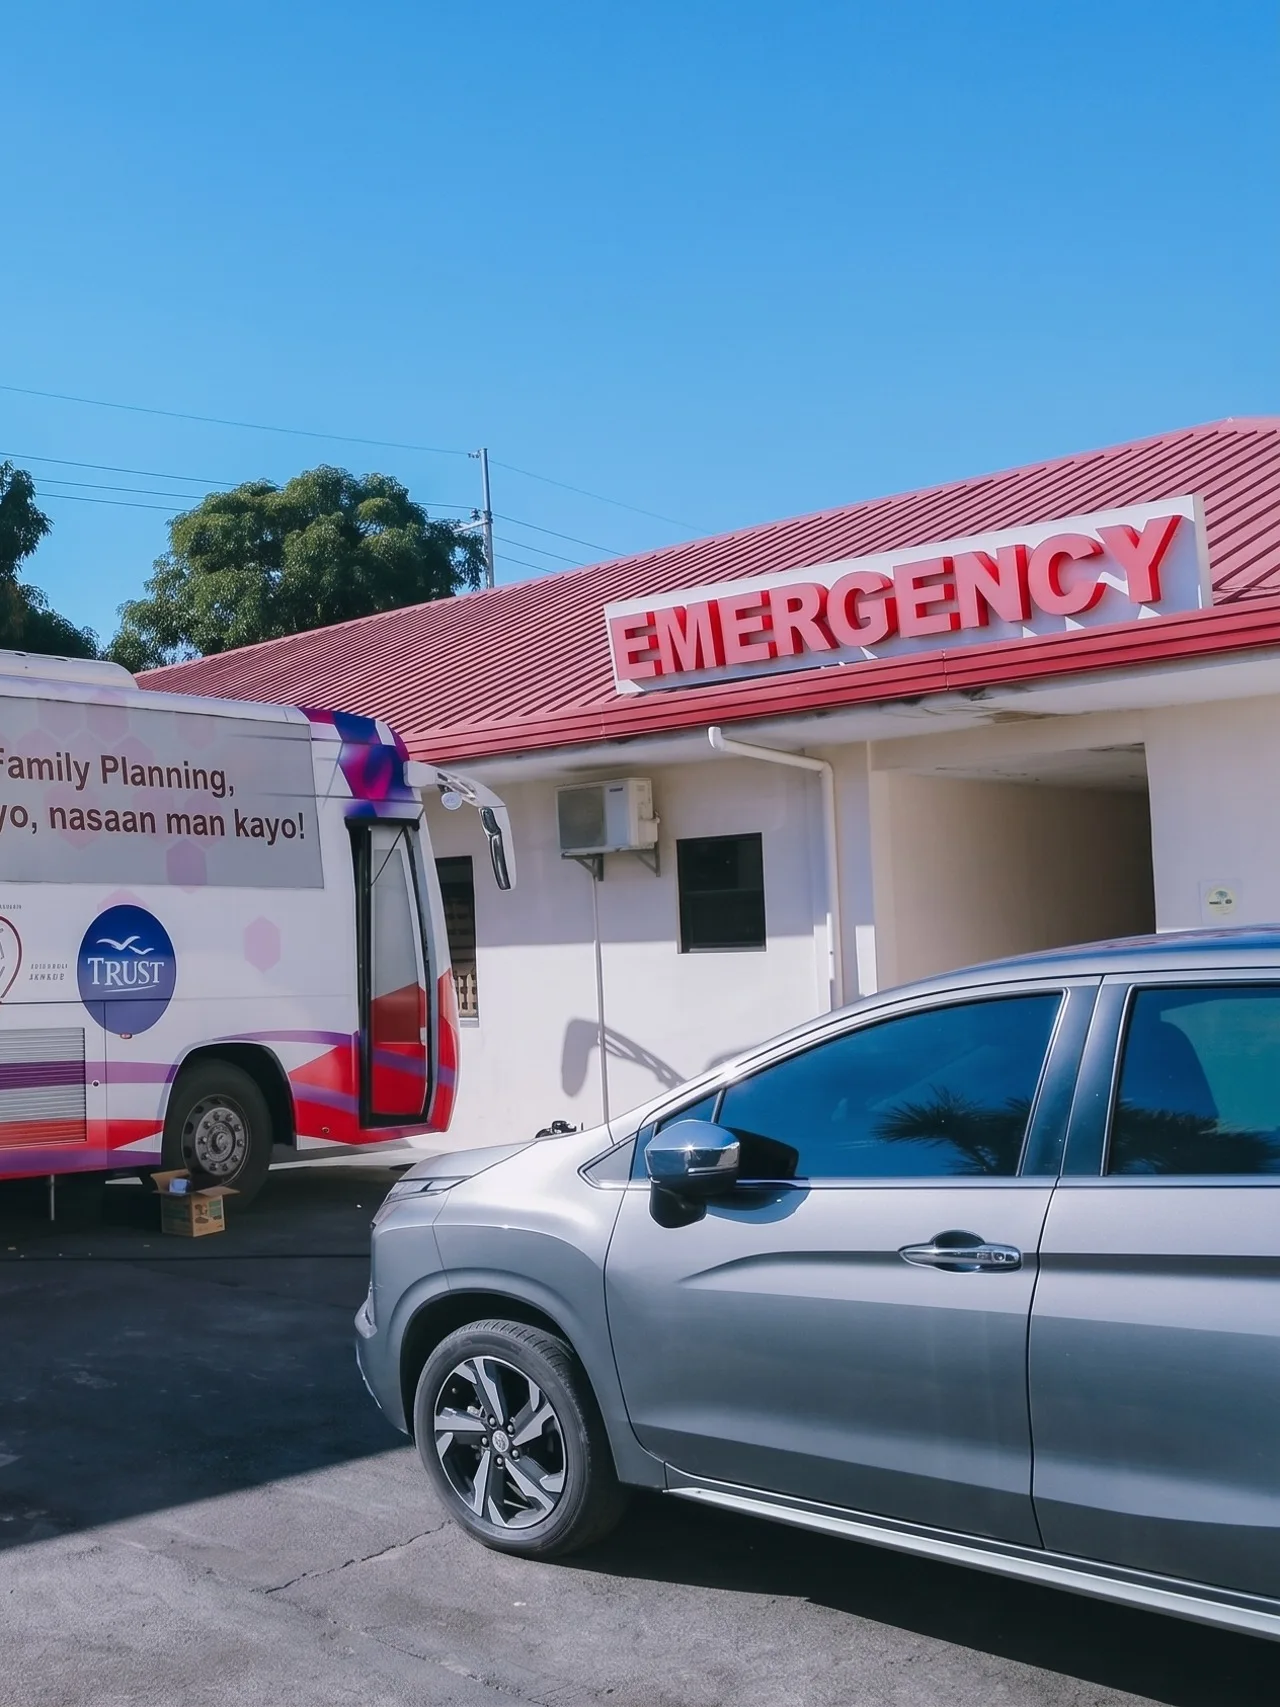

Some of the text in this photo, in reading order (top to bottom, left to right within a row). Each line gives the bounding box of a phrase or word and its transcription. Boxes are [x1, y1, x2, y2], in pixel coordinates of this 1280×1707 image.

[617, 514, 1183, 681] EMERGENCY
[100, 754, 234, 797] Planning,
[49, 805, 156, 834] nasaan
[166, 812, 225, 836] man
[233, 809, 305, 845] kayo!
[87, 957, 164, 986] TRUST
